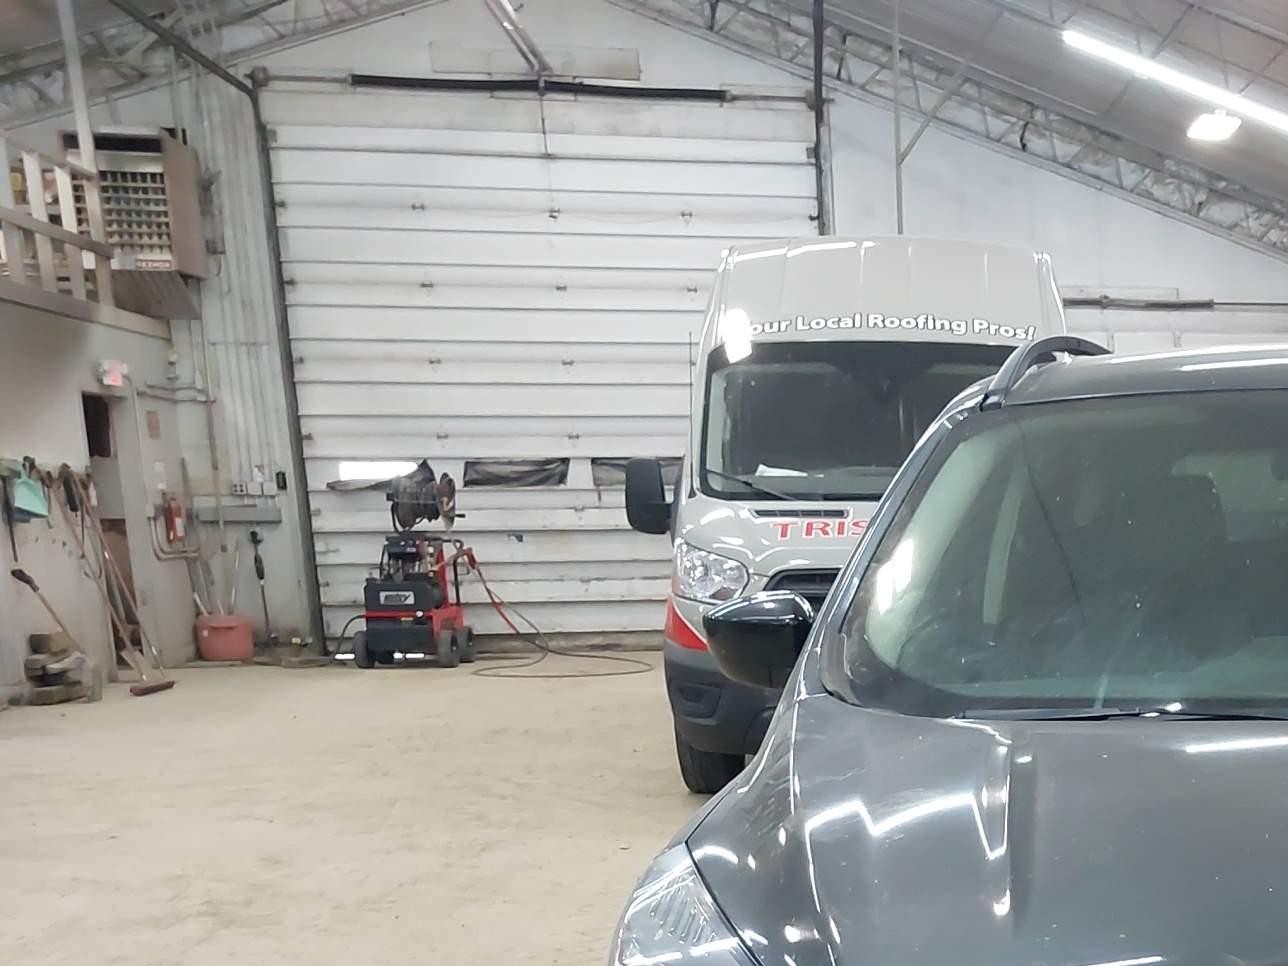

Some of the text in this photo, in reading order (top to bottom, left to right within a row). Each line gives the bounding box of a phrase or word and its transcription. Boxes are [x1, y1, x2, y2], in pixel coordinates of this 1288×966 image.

[749, 312, 1037, 341] our Local Roofing Pros!
